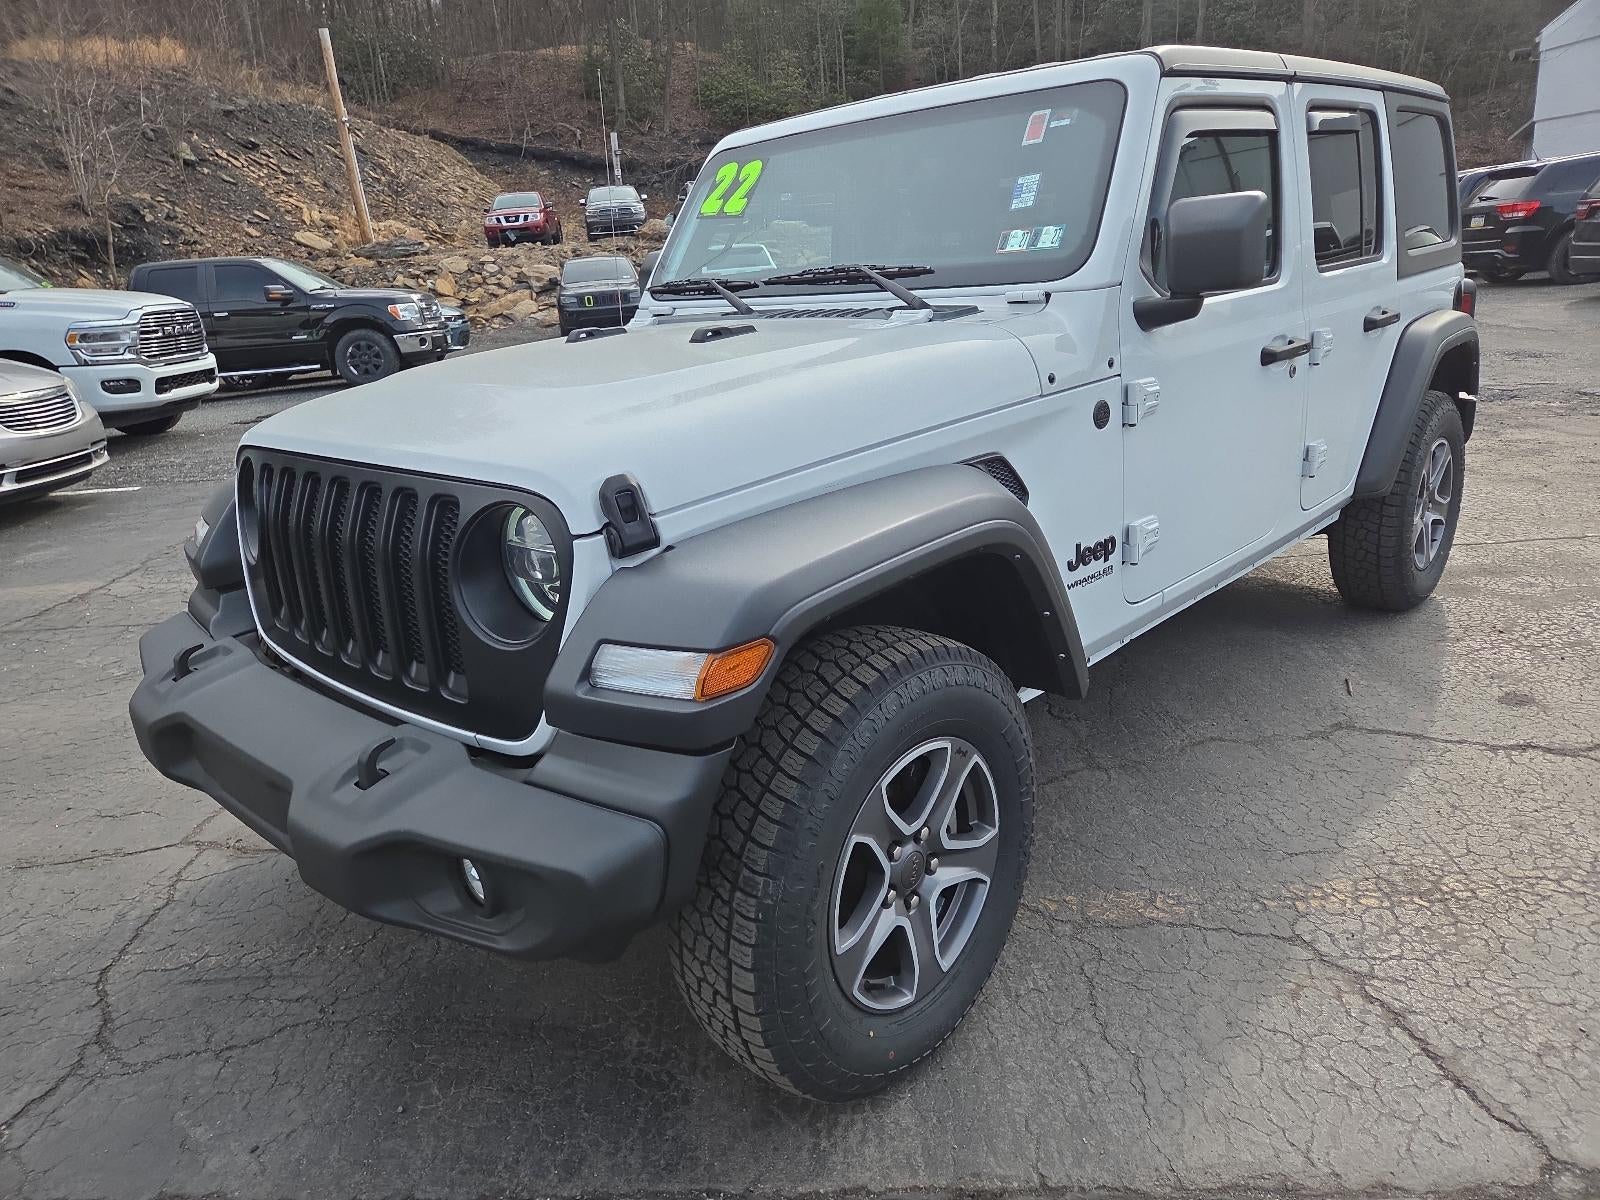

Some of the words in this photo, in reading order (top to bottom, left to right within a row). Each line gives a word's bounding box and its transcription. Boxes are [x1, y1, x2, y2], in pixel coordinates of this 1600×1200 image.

[700, 159, 763, 216] 22
[163, 322, 195, 336] RAM
[1067, 535, 1116, 572] Jeep
[1067, 565, 1113, 590] WRANGLER
